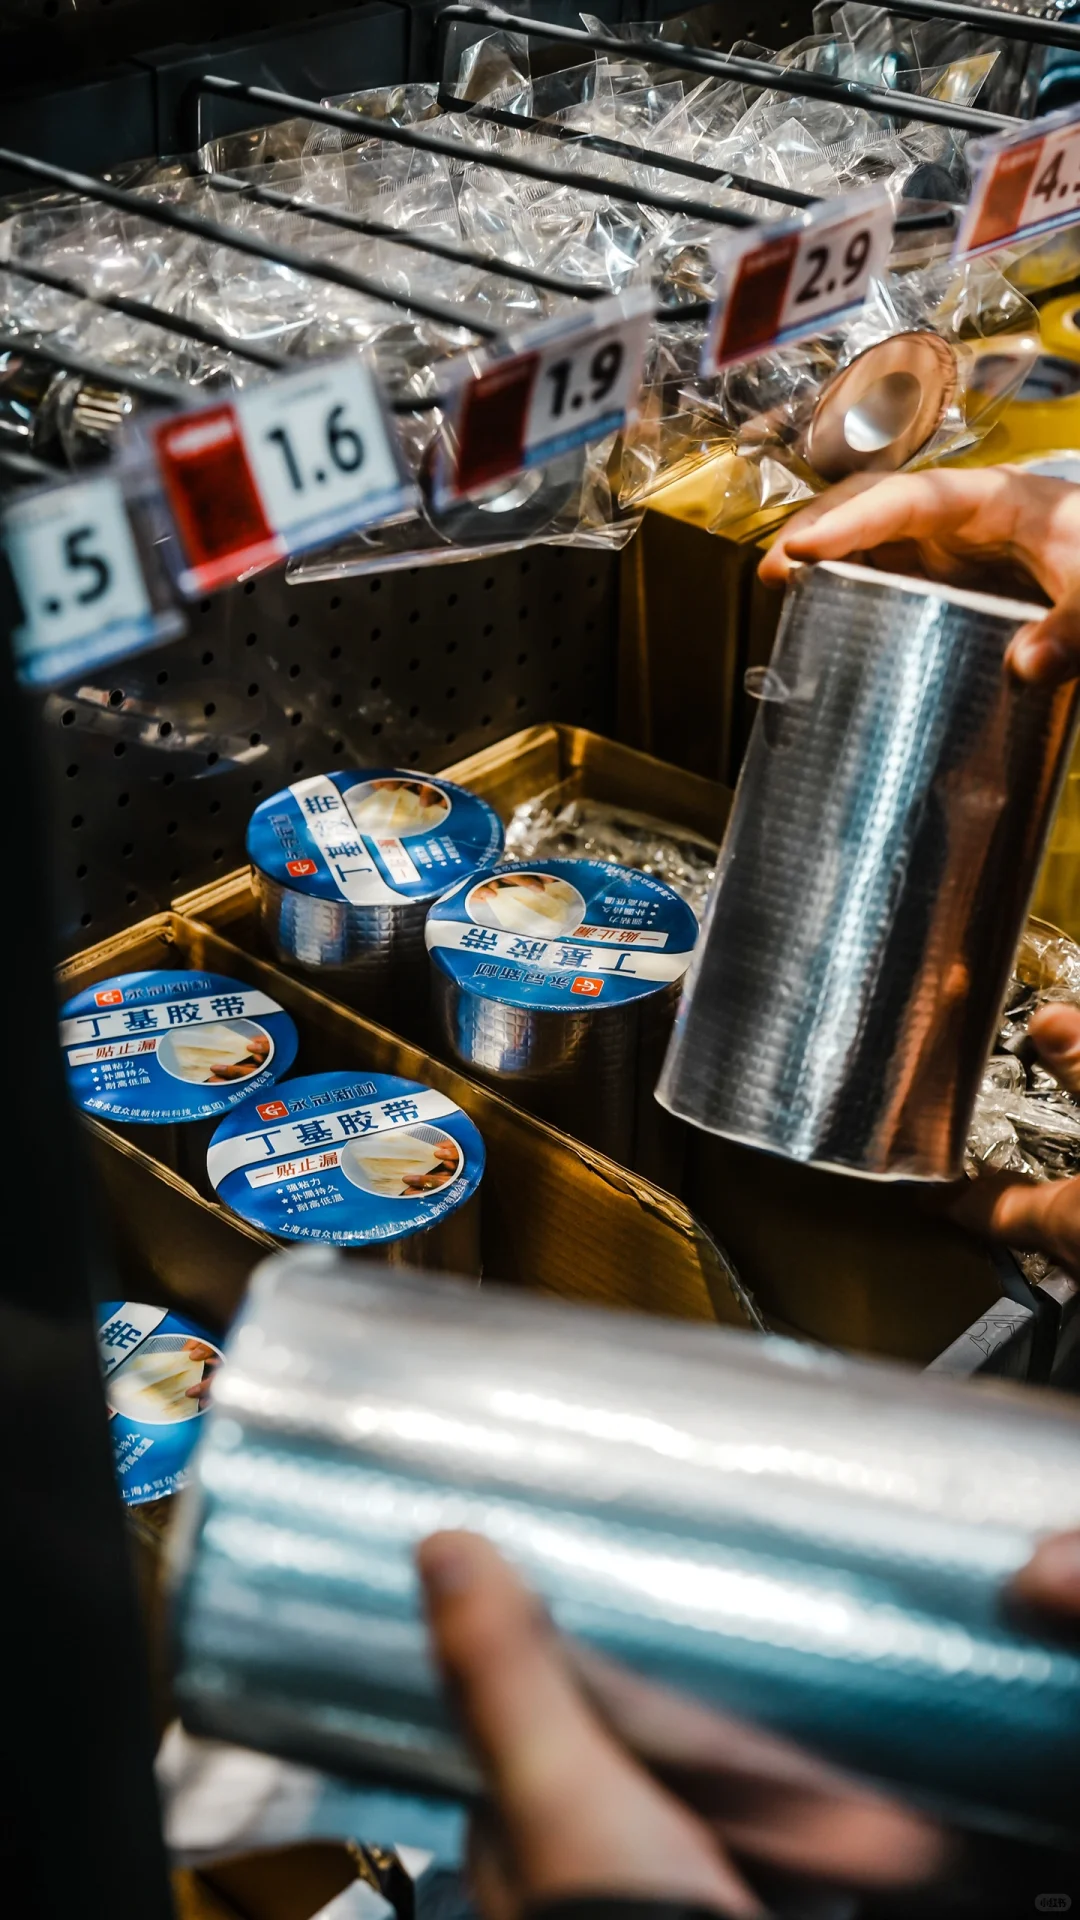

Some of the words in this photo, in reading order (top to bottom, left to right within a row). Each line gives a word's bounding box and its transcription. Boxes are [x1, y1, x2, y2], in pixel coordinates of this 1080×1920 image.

[1031, 146, 1080, 205] 4.
[793, 229, 872, 307] 2.9
[546, 340, 625, 418] 1.9
[264, 403, 365, 493] 1.6
[572, 924, 660, 944] 一贴止漏
[459, 927, 638, 975] 丁基胶带
[475, 962, 570, 990] 永冠新材
[76, 995, 246, 1038] 丁基胶带
[76, 1038, 157, 1059] 一贴止漏
[100, 1061, 134, 1073] 强粘力
[105, 1076, 151, 1090] 耐高低温
[289, 1081, 378, 1113] 永冠新材
[245, 1099, 419, 1156] 丁基胶带
[255, 1151, 339, 1180] 一贴止漏
[285, 1177, 321, 1194] 强粘力
[291, 1184, 340, 1203] 补漏持久
[296, 1193, 345, 1213] 耐高低温
